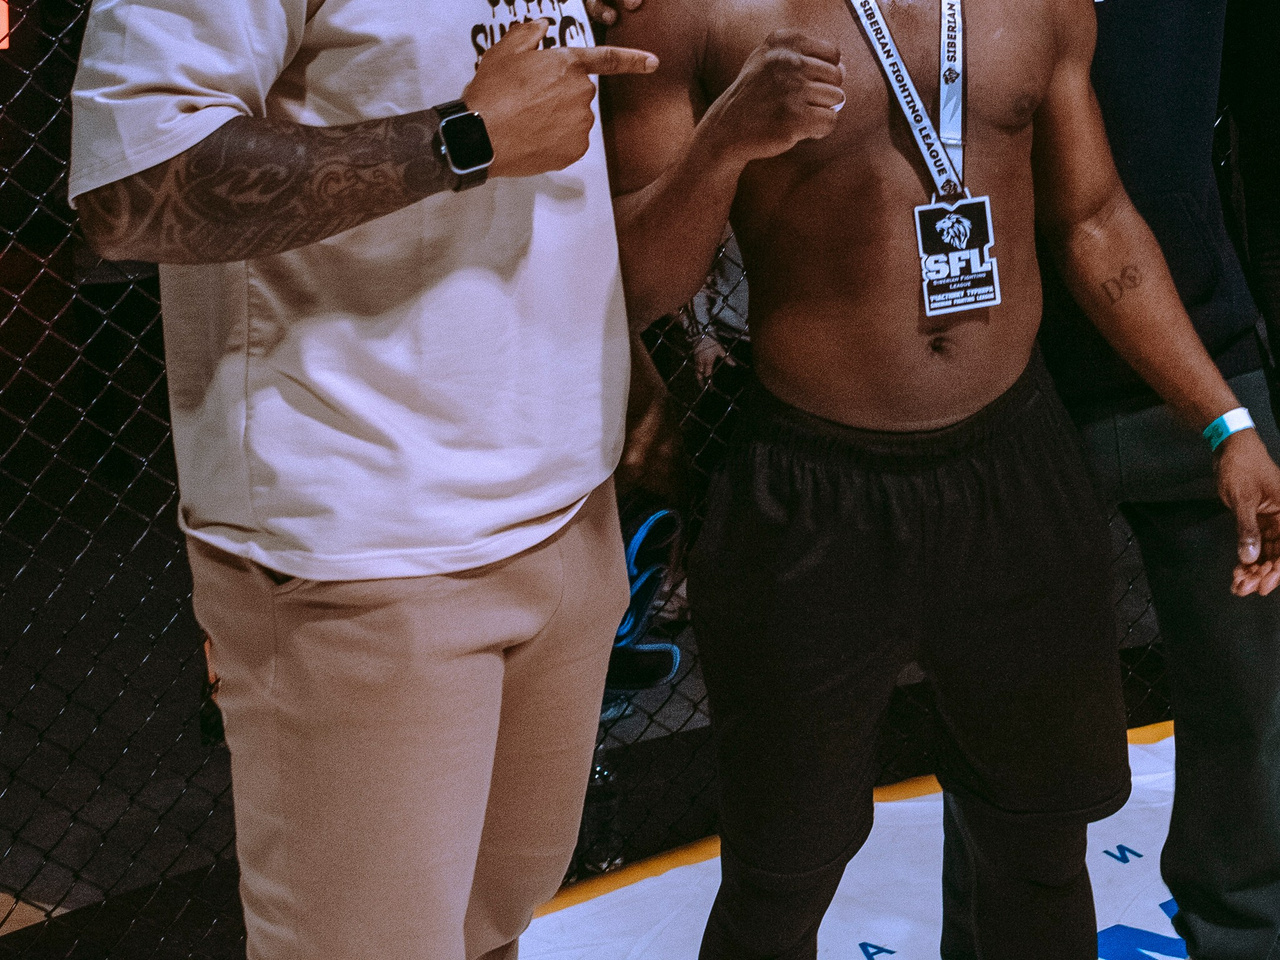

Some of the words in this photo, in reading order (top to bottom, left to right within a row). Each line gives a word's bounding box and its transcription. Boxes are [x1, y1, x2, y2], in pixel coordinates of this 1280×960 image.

[946, 2, 957, 63] SIBERIAN
[860, 0, 894, 60] SIBERIAN
[889, 61, 923, 122] FIGHTING
[918, 126, 948, 177] LEAGUE
[926, 248, 992, 281] SFL
